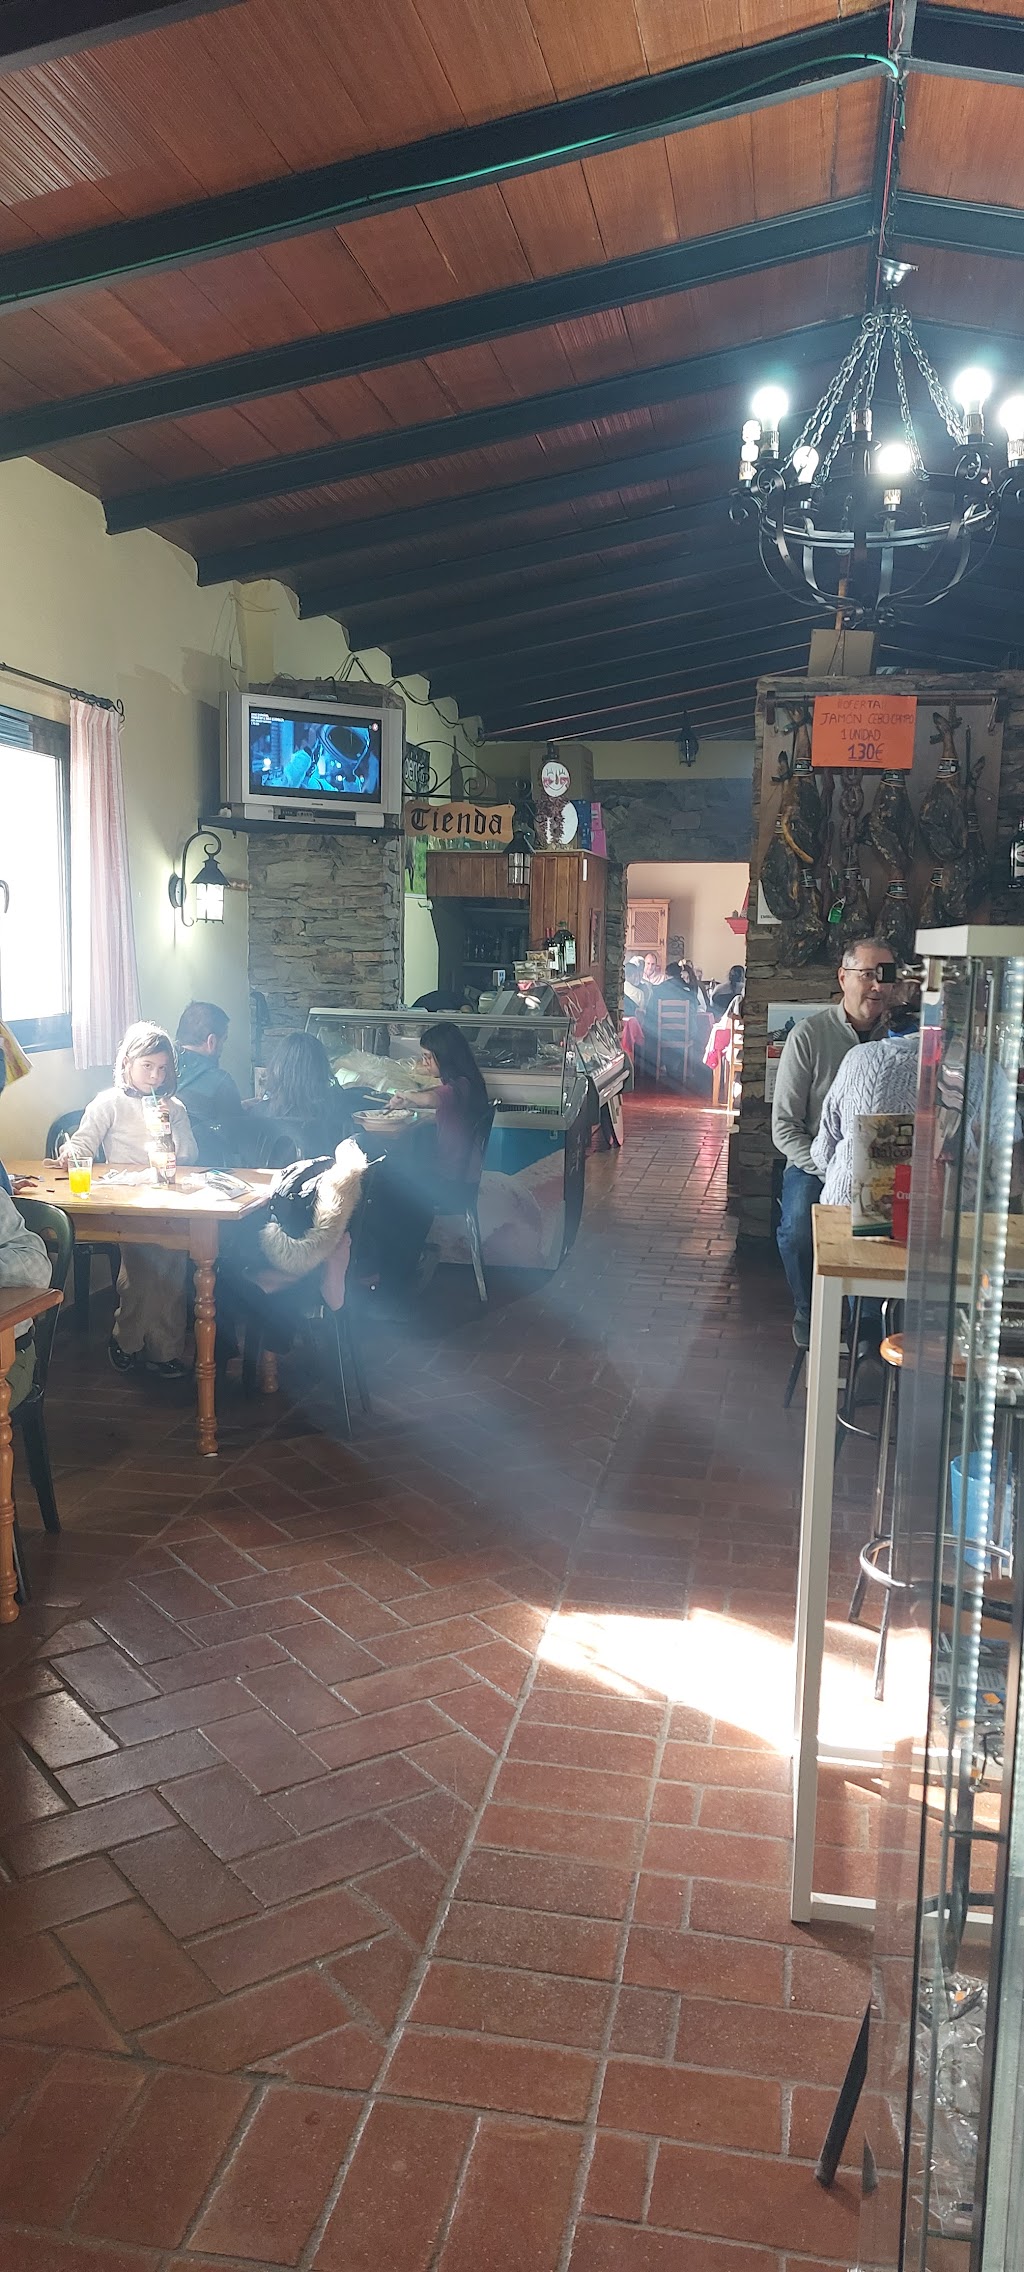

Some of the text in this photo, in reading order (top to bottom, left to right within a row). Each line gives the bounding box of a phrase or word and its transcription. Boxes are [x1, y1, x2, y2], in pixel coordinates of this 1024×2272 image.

[841, 728, 881, 740] 1 UNIDAD
[848, 743, 885, 761] 130€
[410, 807, 502, 835] Tienda
